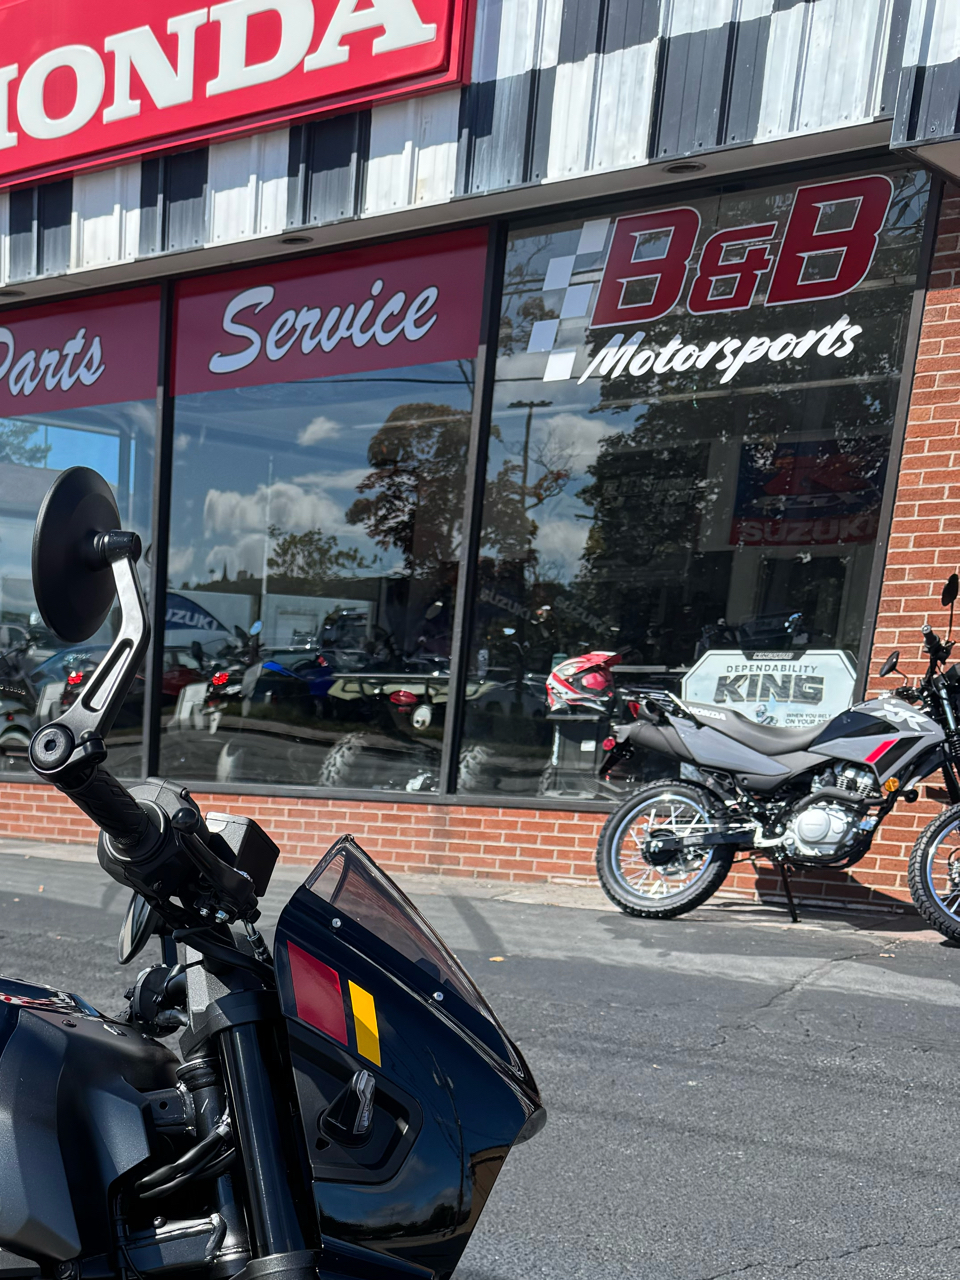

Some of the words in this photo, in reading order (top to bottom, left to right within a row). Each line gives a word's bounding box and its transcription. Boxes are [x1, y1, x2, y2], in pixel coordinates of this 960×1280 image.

[589, 174, 894, 331] B&B
[207, 278, 440, 376] Service
[577, 314, 865, 386] Motorsports
[713, 673, 825, 706] KING
[726, 664, 818, 674] DEPENDABILITY
[689, 706, 727, 721] HONDA
